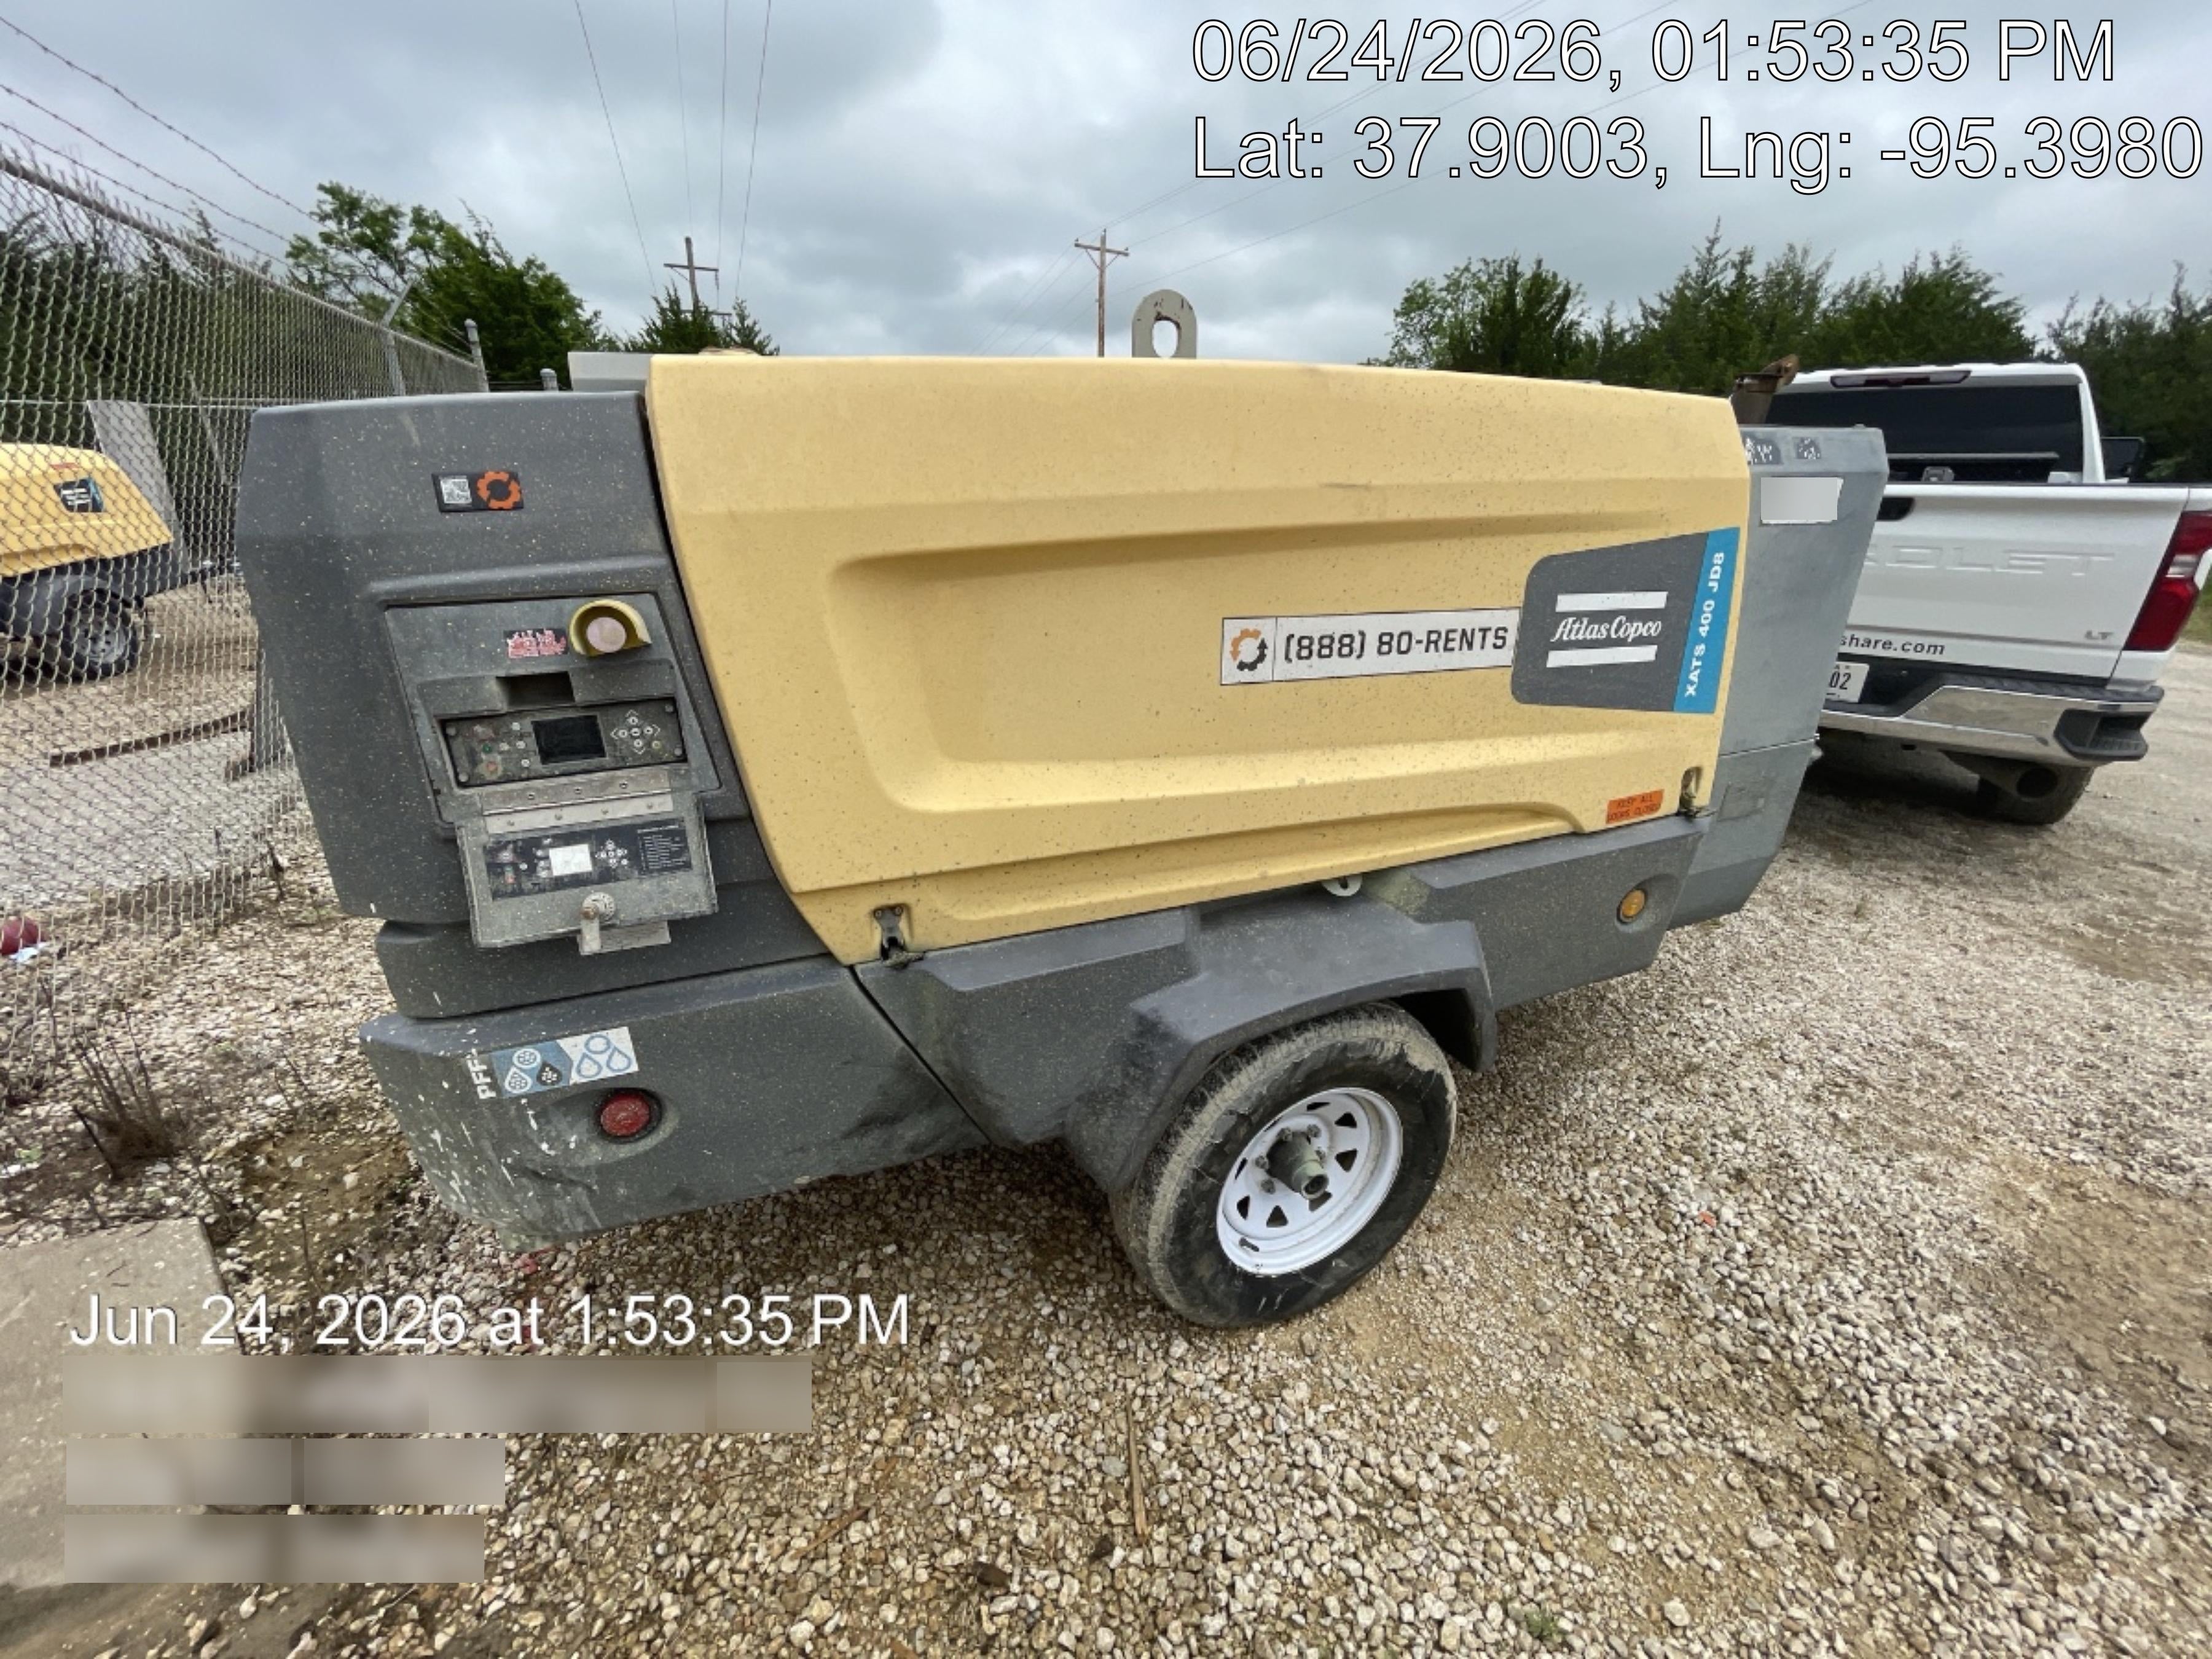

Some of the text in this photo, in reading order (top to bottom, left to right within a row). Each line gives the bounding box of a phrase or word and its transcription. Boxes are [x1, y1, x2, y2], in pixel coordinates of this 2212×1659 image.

[1284, 626, 1509, 663] (888) 80-RENTS
[1550, 615, 1662, 643] Atlas Copco
[1685, 643, 1706, 697] XATS
[1699, 600, 1715, 638] 400
